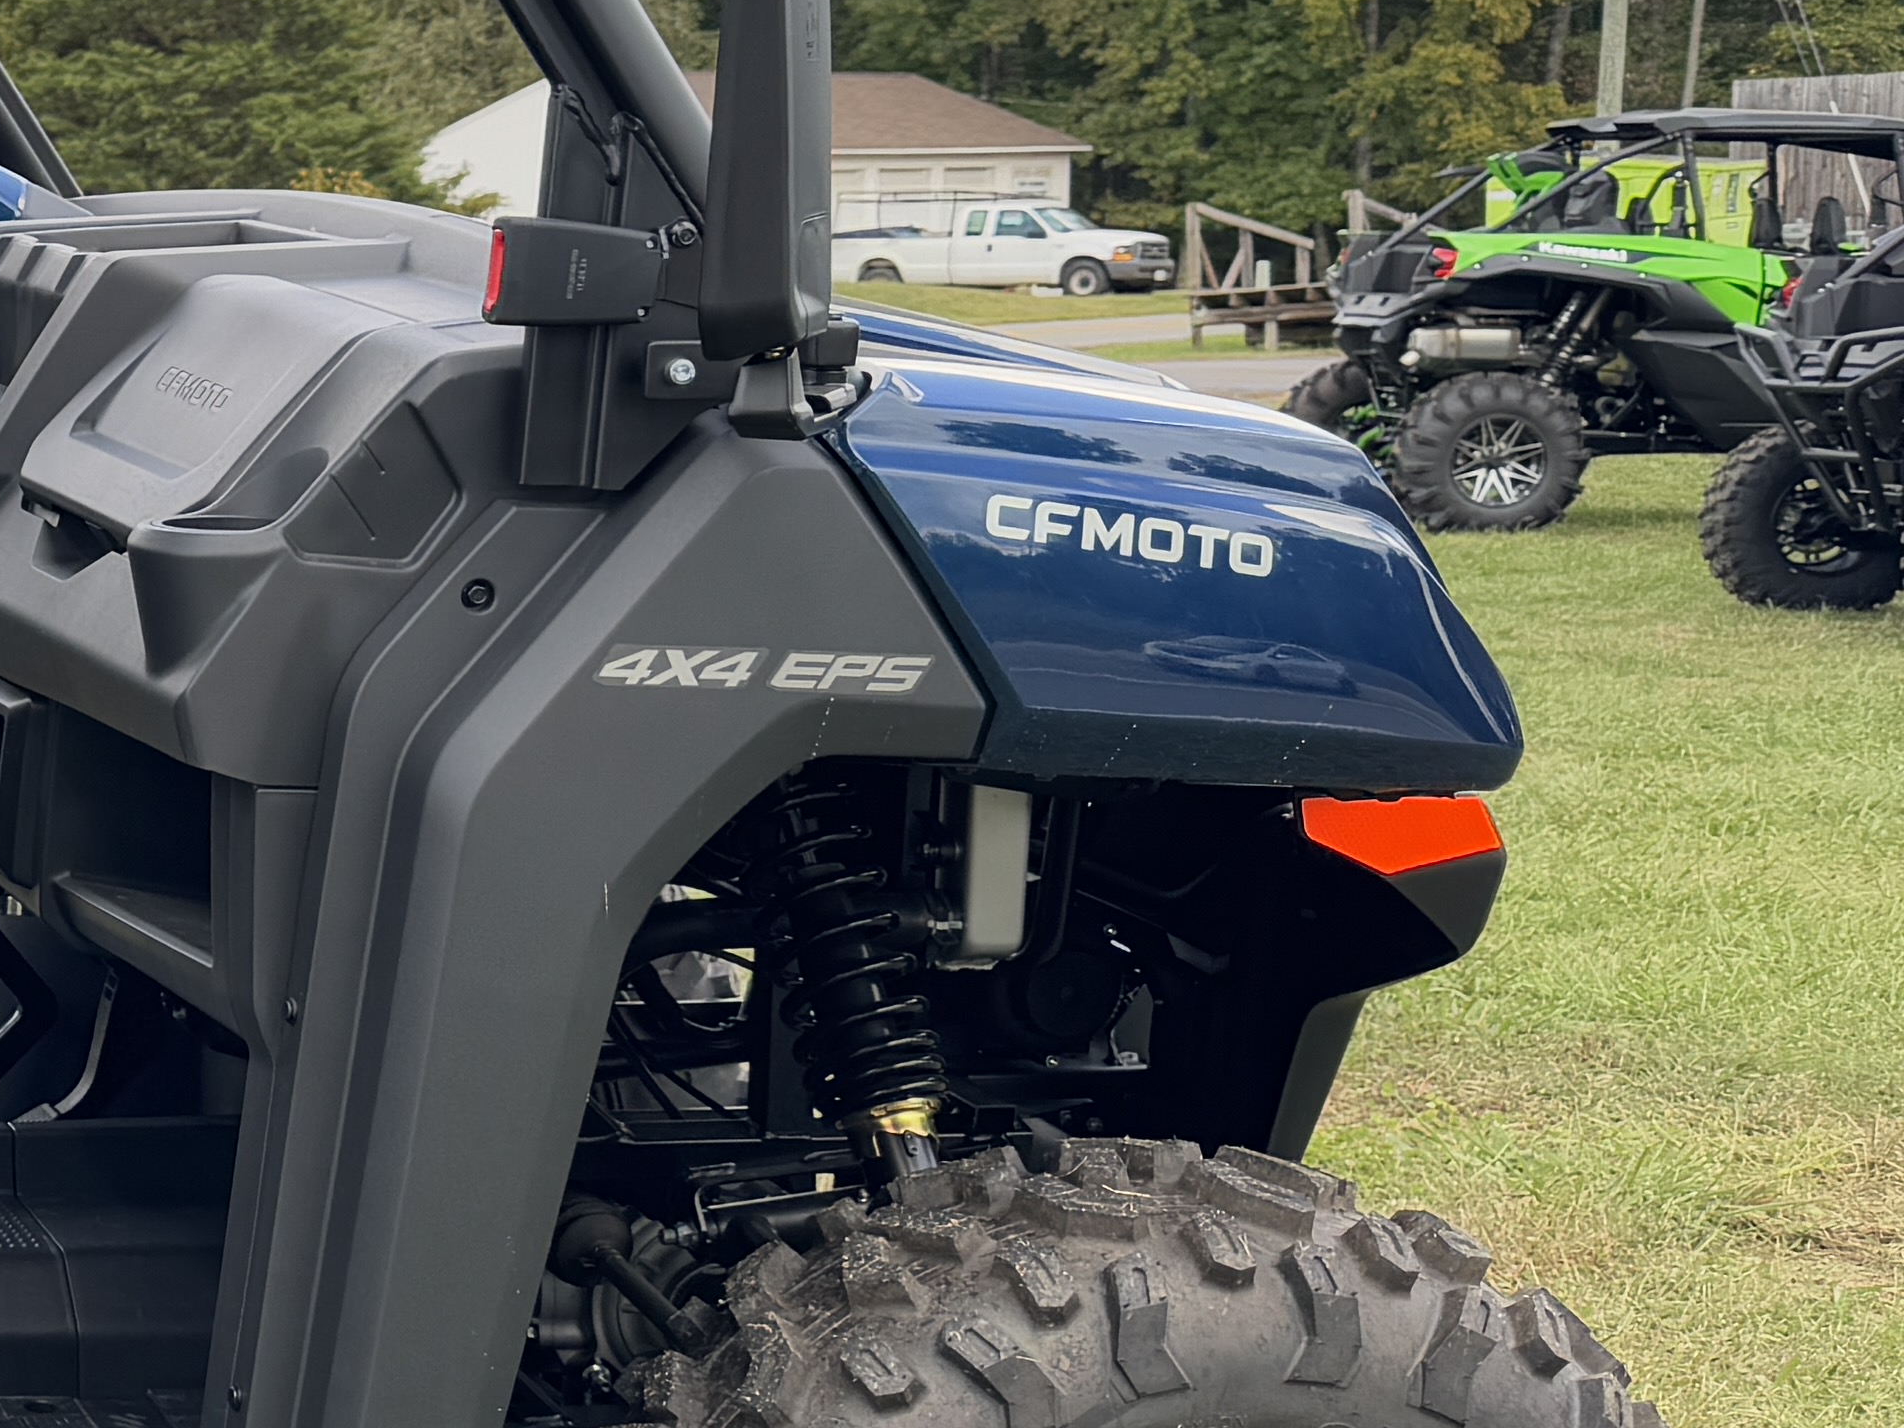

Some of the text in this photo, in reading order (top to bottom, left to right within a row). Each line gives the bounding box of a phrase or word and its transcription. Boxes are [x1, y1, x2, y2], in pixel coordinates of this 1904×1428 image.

[155, 365, 234, 413] CFMOTO
[983, 493, 1275, 579] CFMOTO
[597, 648, 932, 693] 4X4 EPS
